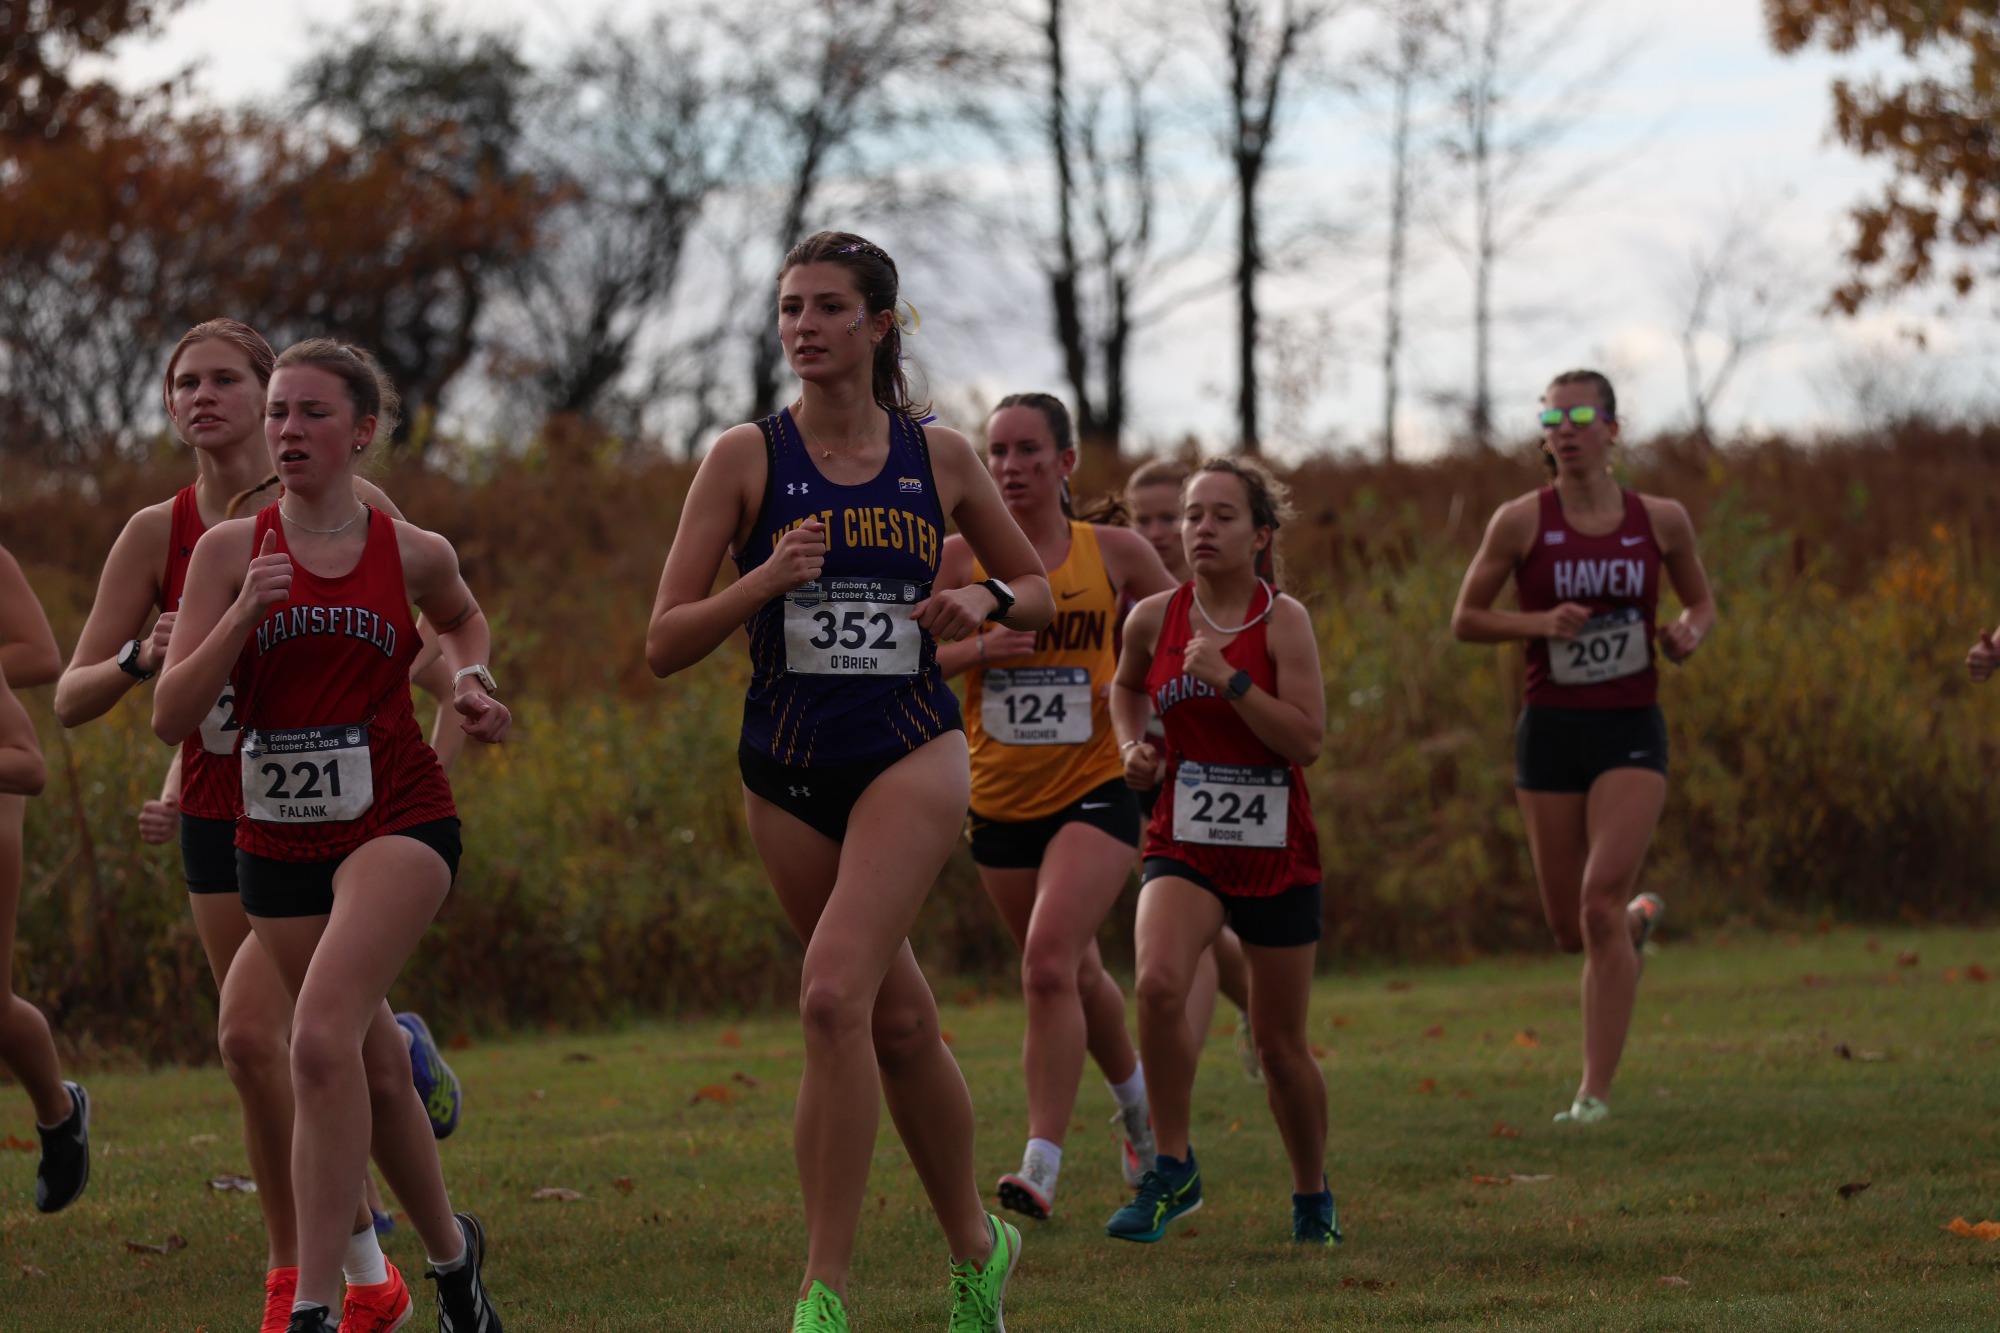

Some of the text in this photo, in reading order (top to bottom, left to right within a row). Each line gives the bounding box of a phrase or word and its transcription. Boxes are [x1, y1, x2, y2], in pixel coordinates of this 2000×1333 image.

[844, 507, 938, 572] CHESTER
[831, 581, 882, 590] Edinboro, PA
[1554, 559, 1645, 599] HAVEN
[831, 591, 897, 601] October 25, 2025
[256, 605, 397, 659] MANSFIELD
[810, 610, 897, 650] 352
[1034, 610, 1106, 651] NON
[830, 655, 878, 669] O'BRIEN
[1568, 632, 1630, 668] 207
[1004, 694, 1066, 724] 124
[270, 731, 322, 742] Edinboro, PA
[271, 738, 339, 751] October 25, 2025
[1013, 728, 1058, 740] TAUCHER
[261, 759, 341, 799] 221
[279, 804, 327, 818] FALANK
[1190, 790, 1268, 826] 224
[1208, 827, 1244, 841] MOORE
